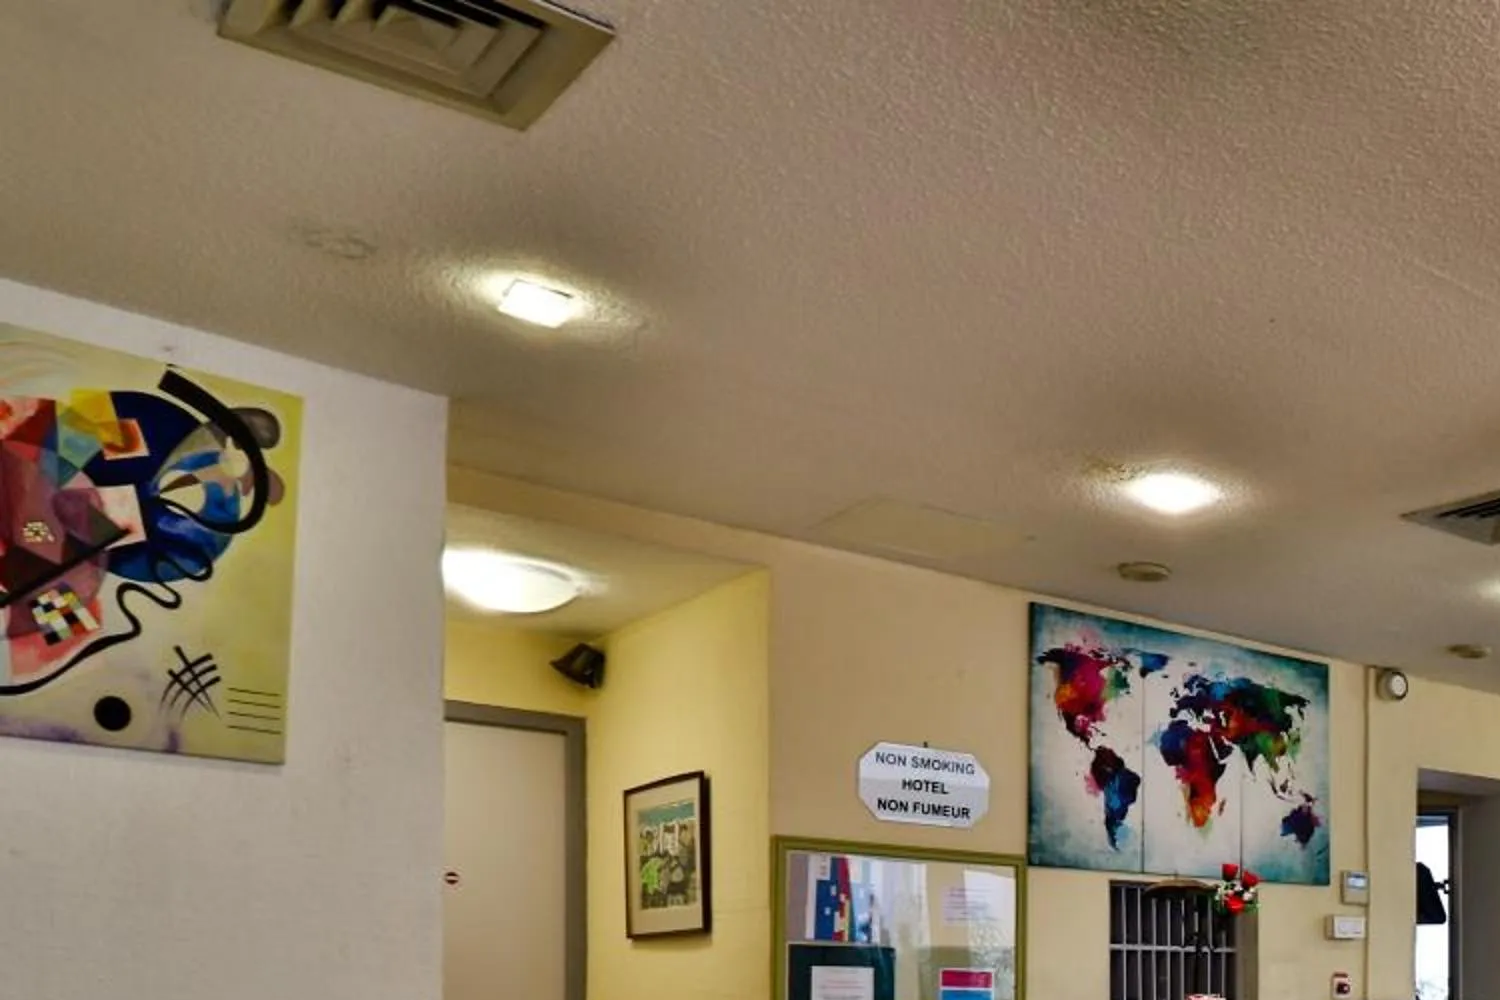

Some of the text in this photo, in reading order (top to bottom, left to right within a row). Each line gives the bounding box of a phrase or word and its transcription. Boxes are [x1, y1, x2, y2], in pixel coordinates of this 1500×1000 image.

[875, 752, 975, 775] NON SMOKING
[902, 779, 949, 795] HOTEL
[877, 798, 971, 820] NON FUMEUR
